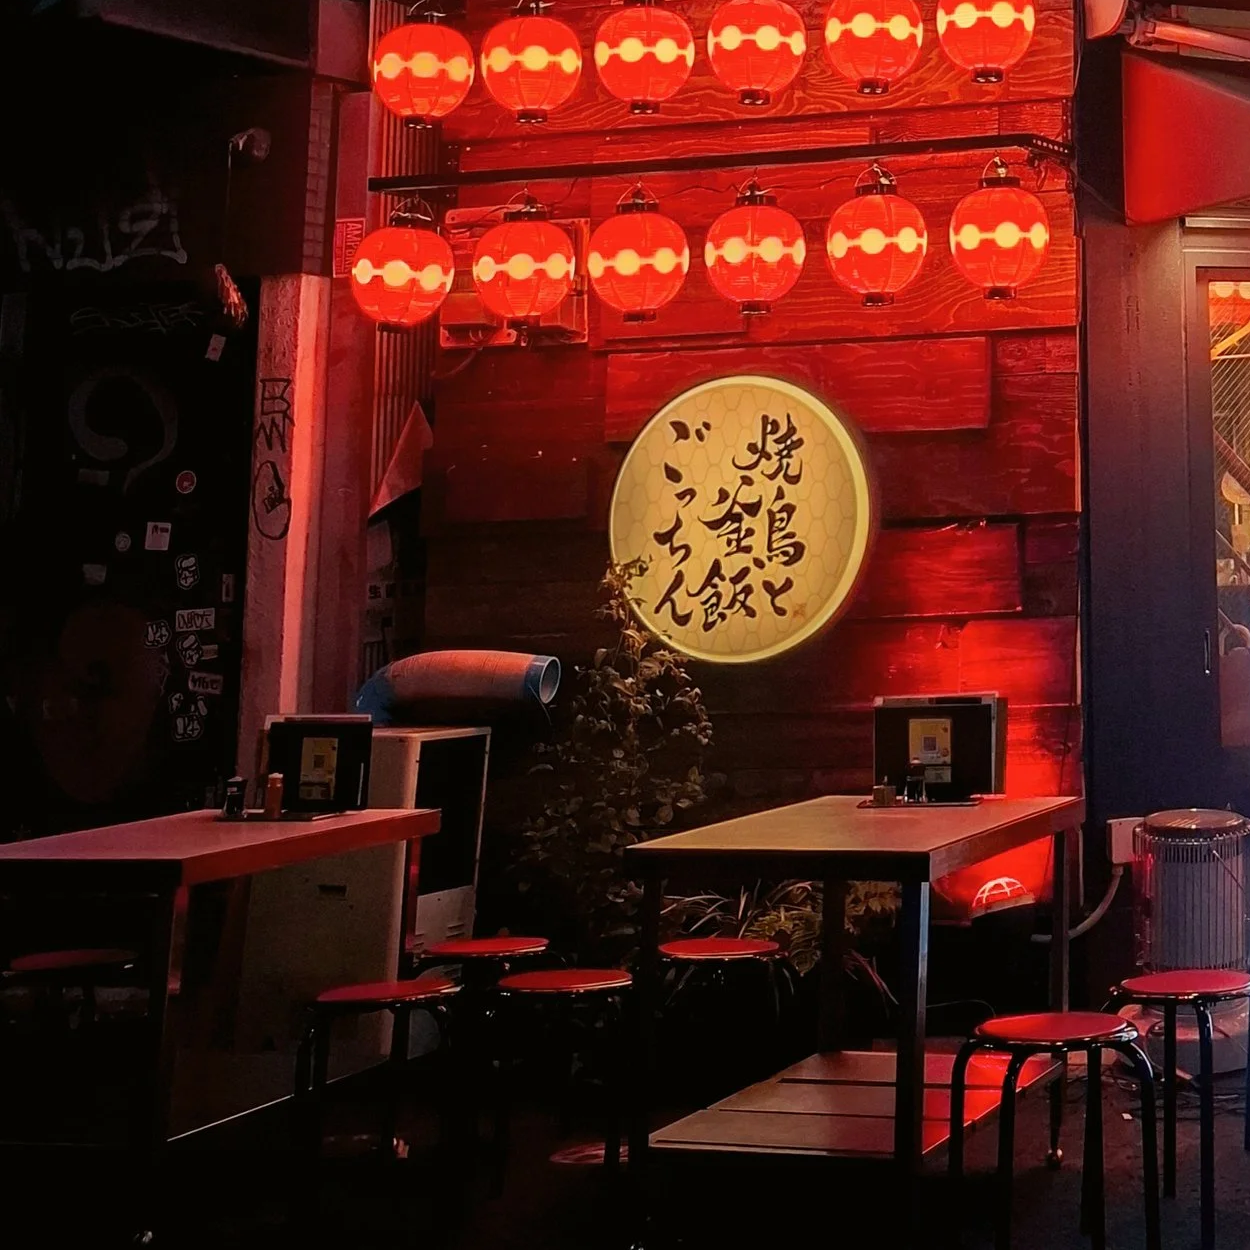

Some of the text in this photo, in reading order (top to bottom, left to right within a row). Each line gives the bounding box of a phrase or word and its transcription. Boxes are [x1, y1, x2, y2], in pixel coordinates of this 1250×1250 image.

[654, 420, 712, 626] ごっちん
[687, 475, 763, 632] 釜飯
[732, 413, 805, 616] 焼鳥と
